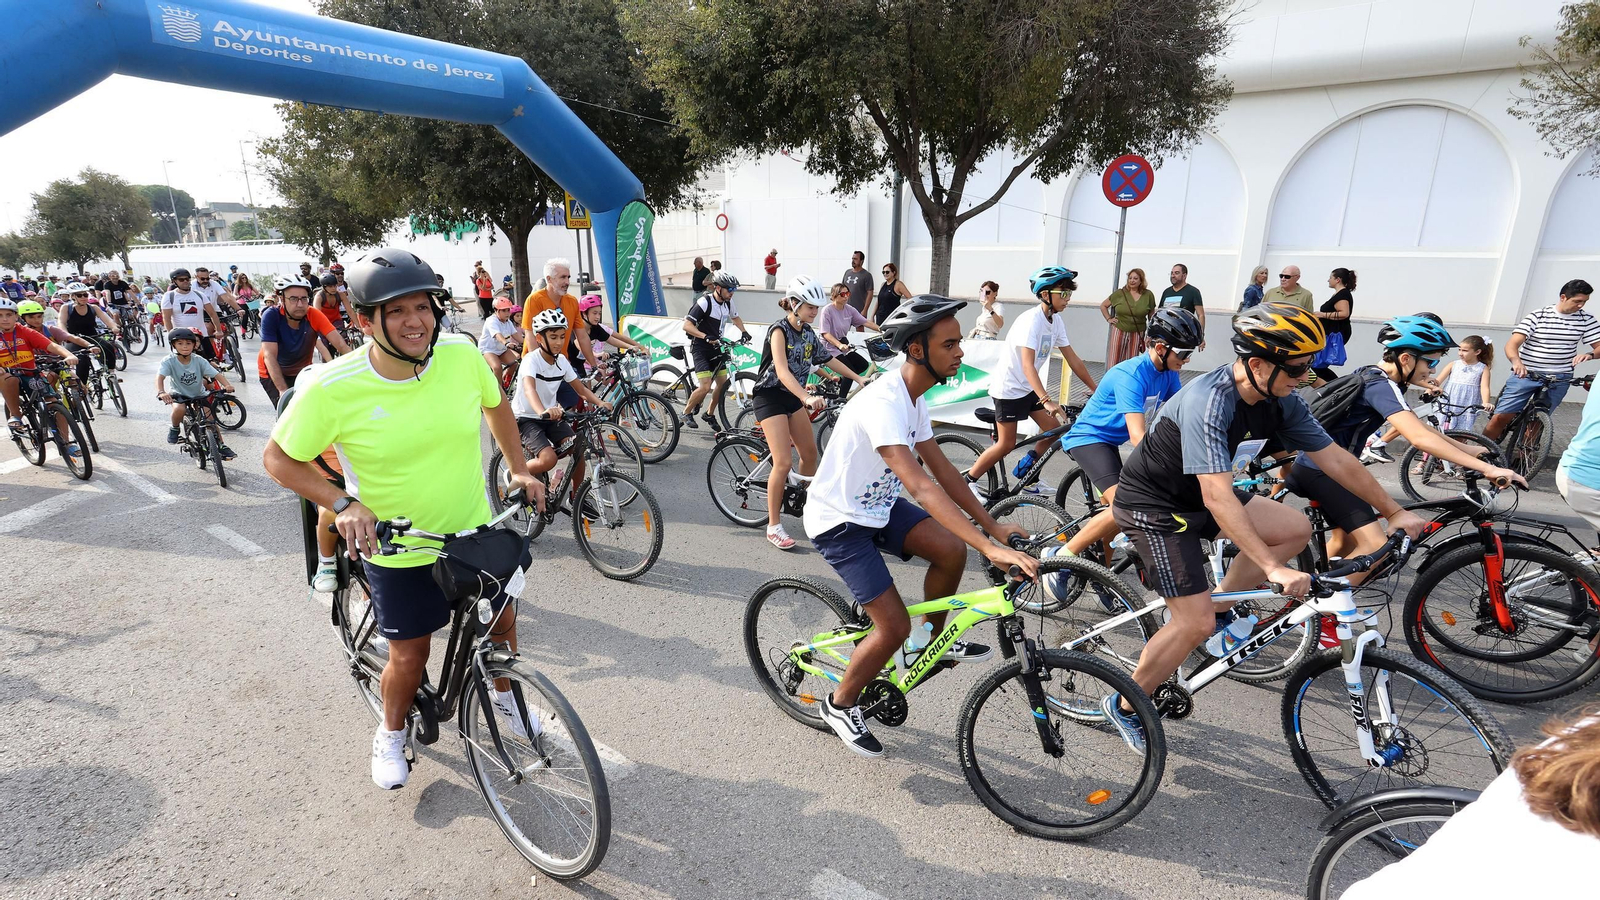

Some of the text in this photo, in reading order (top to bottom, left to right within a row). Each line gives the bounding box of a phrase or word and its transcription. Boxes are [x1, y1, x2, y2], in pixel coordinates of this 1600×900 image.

[213, 36, 313, 63] Deportes
[213, 20, 496, 81] Ayuntamiento de Jerez
[1018, 446, 1053, 487] ROCKRIDER
[903, 623, 959, 687] ROCKRIDER
[1221, 616, 1296, 667] TREK
[1349, 692, 1370, 733] FOX
[1302, 766, 1337, 811] NTRAGER
